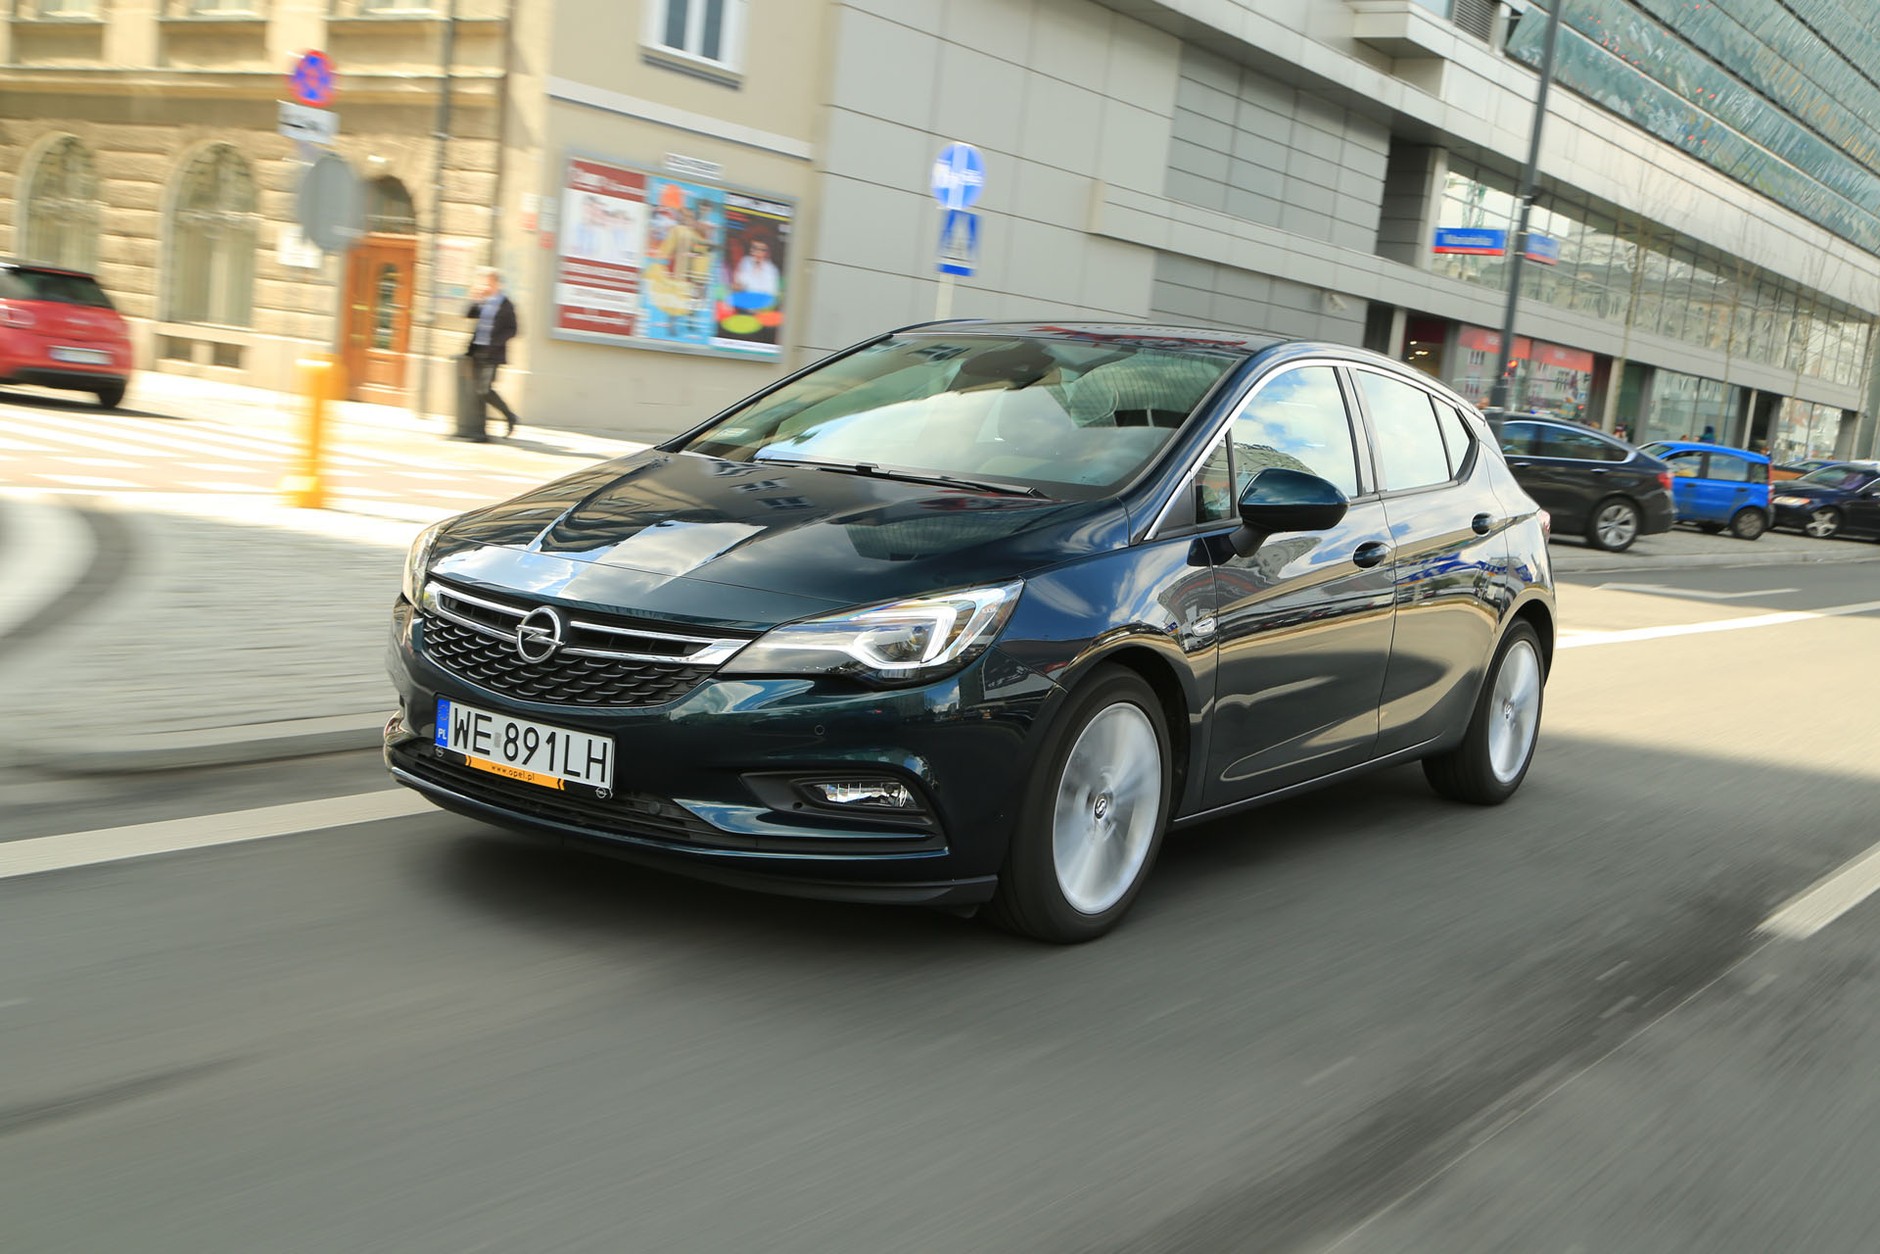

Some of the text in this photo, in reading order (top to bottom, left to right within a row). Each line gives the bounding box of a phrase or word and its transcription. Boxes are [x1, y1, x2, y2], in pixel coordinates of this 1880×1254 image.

[437, 727, 447, 740] PL
[454, 707, 608, 783] WE 891LH
[491, 765, 535, 781] www.opel.pl
